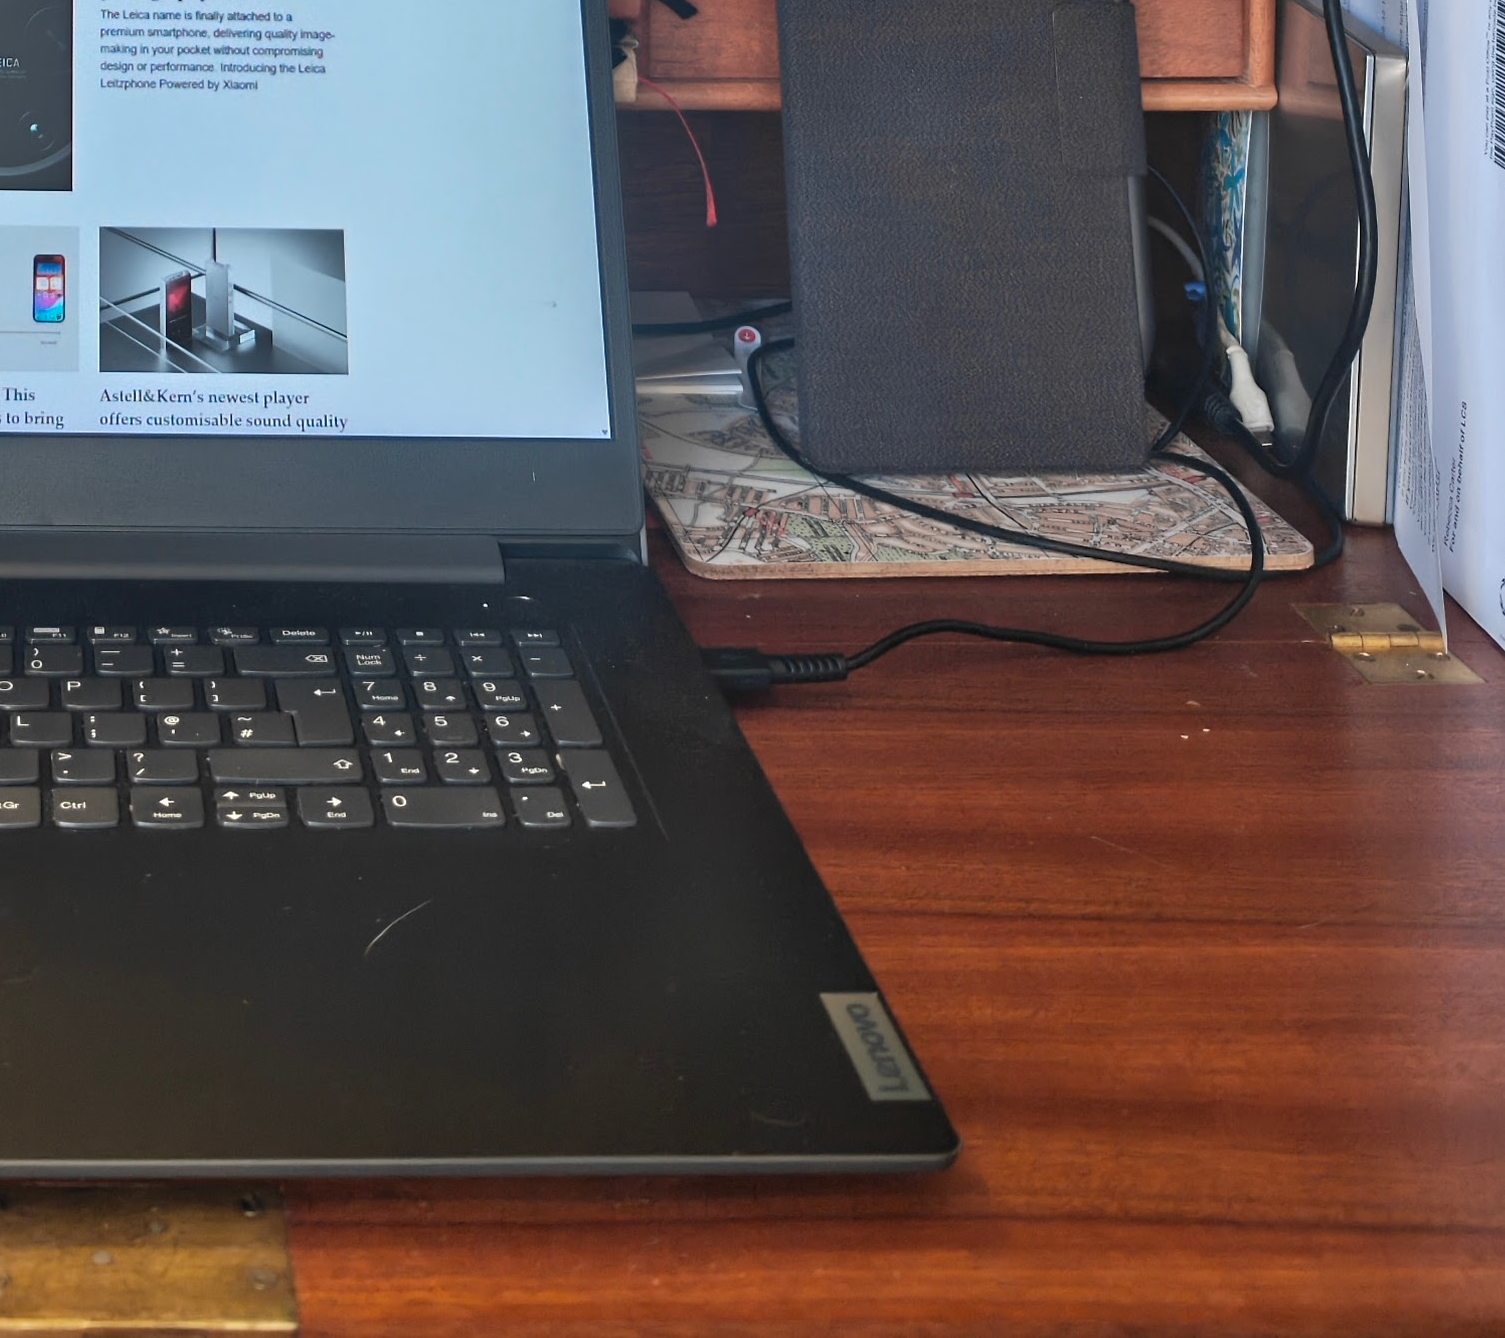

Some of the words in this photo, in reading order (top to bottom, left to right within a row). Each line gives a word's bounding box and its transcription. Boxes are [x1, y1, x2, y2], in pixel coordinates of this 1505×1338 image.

[101, 9, 120, 19] The
[123, 10, 150, 19] Leica
[153, 12, 181, 20] name
[196, 11, 224, 23] finally
[227, 12, 270, 21] attached
[273, 13, 283, 21] to
[100, 28, 144, 38] premium
[148, 28, 210, 39] smartphone,
[213, 29, 262, 41] delivering
[265, 29, 298, 41] quality
[300, 31, 335, 41] image-
[100, 45, 137, 56] making
[140, 46, 149, 54] in
[152, 46, 174, 56] your
[177, 46, 210, 56] pocket
[214, 46, 250, 55] without
[252, 48, 323, 59] compromising
[100, 62, 134, 73] design
[137, 63, 147, 71] or
[221, 63, 277, 75] Introducing
[279, 64, 296, 73] the
[298, 64, 326, 73] Leica
[101, 79, 156, 90] Leitzphone
[159, 79, 204, 89] Powered
[208, 80, 219, 91] by
[223, 80, 258, 90] Xiaomi
[6, 388, 35, 401] This
[209, 393, 258, 403] newest
[264, 391, 309, 408] player
[7, 413, 19, 424] to
[25, 412, 64, 429] bring
[100, 413, 142, 425] offers
[147, 414, 242, 426] customisable
[247, 414, 291, 427] sound
[296, 415, 346, 432] quality
[249, 792, 276, 800] PgUp
[60, 801, 86, 810] Ctrl
